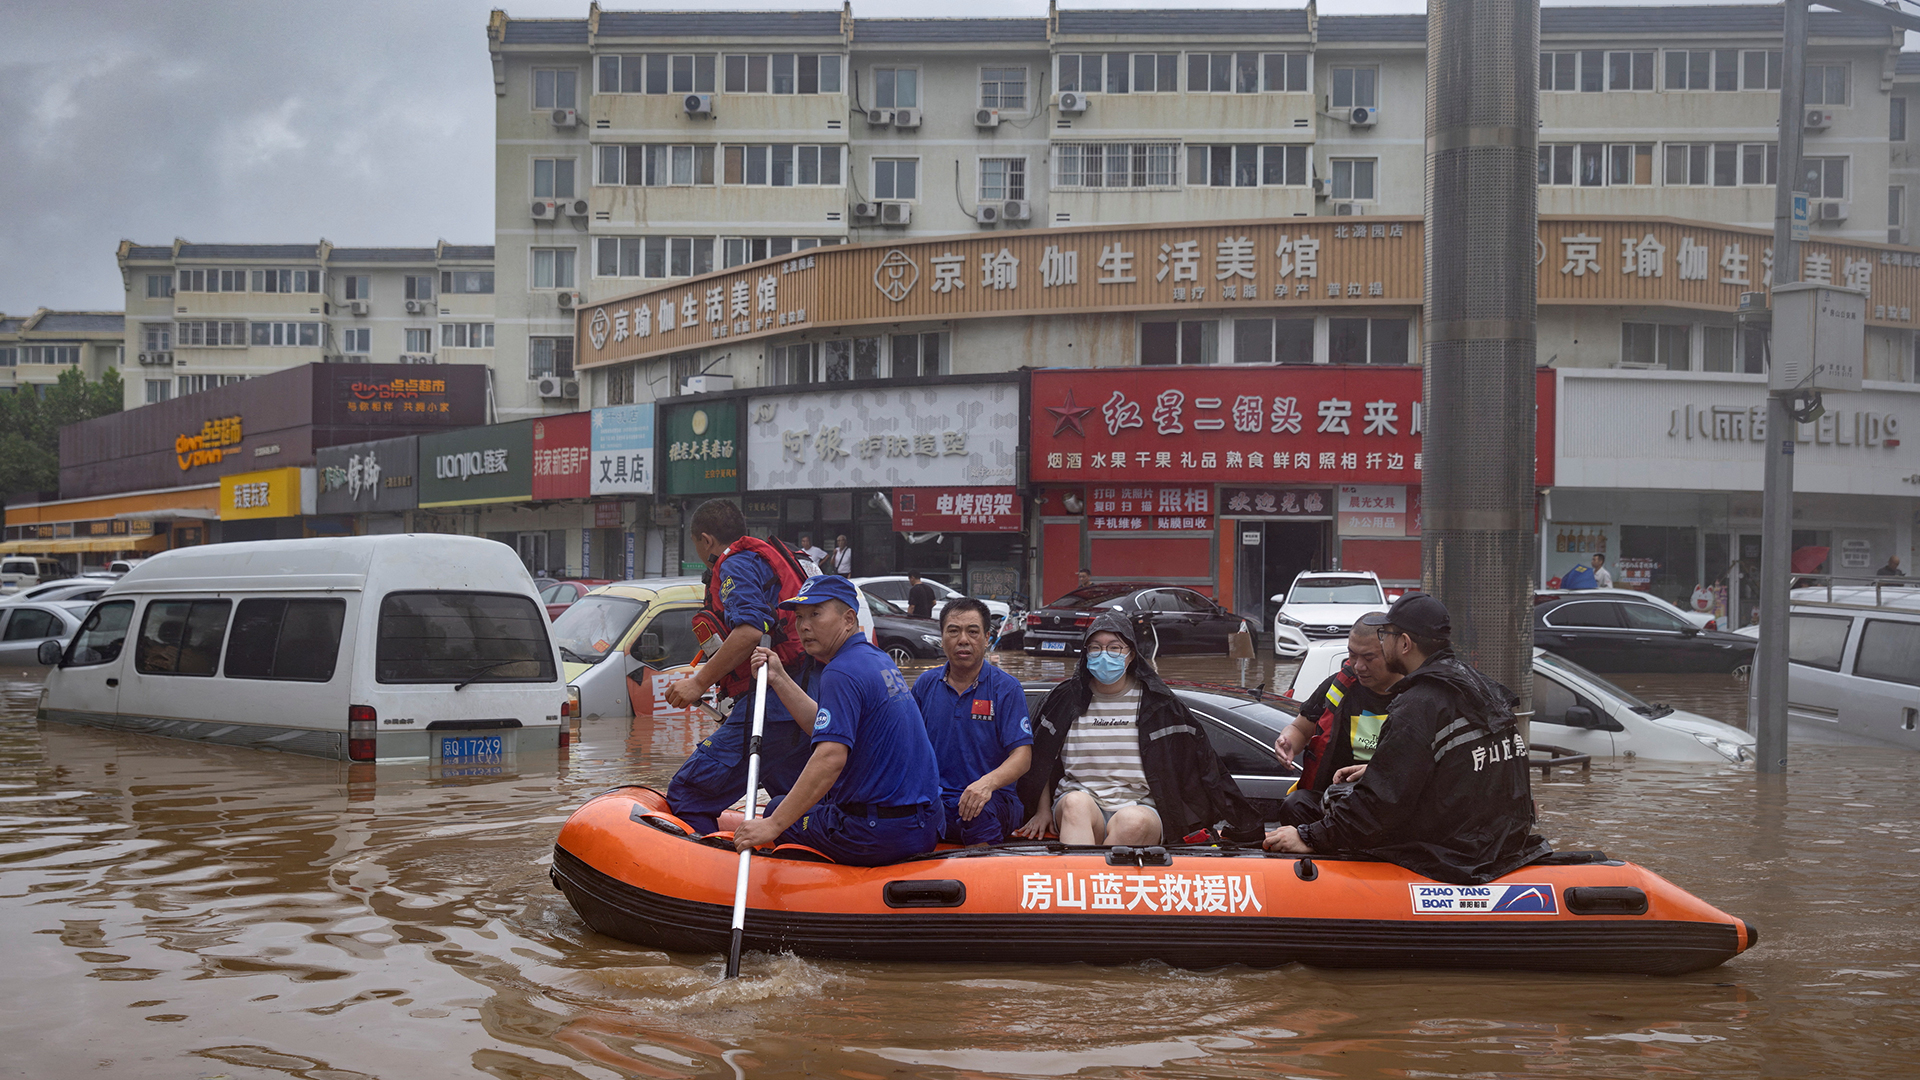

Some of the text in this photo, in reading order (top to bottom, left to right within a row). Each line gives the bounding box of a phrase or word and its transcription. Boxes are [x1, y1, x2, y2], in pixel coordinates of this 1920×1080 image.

[1335, 224, 1404, 239] 北潞园店
[930, 235, 1320, 292] 京瑜伽生活美馆
[1173, 282, 1383, 301] 理疗 减脂 孕产 普拉提
[613, 274, 778, 342] 京瑜伽生活美馆
[390, 379, 445, 392] 点点超市
[1102, 389, 1302, 436] 红星二锅头
[600, 454, 644, 484] 文具店
[1048, 452, 1082, 469] 烟酒
[1091, 452, 1126, 468] 水果
[1135, 452, 1171, 468] 干果
[1180, 452, 1217, 469] 礼品
[1226, 451, 1264, 469] 熟食
[1273, 451, 1311, 469] 鲜肉
[1319, 452, 1357, 469] 照相
[1366, 452, 1404, 470] 扦边
[1094, 488, 1153, 499] 打印 洗照片
[1158, 488, 1208, 513] 照相
[1228, 491, 1324, 513] 欢迎光临
[1349, 496, 1396, 508] 晨光文具
[936, 493, 1013, 515] 电烤鸡架
[1094, 501, 1115, 512] 复印
[1094, 517, 1207, 529] 手机维修 贴膜回收
[1349, 517, 1396, 528] 办公用品
[1020, 872, 1263, 913] 房山蓝天救援队
[1419, 887, 1491, 896] ZHAO YANG
[1421, 899, 1454, 908] BOAT
